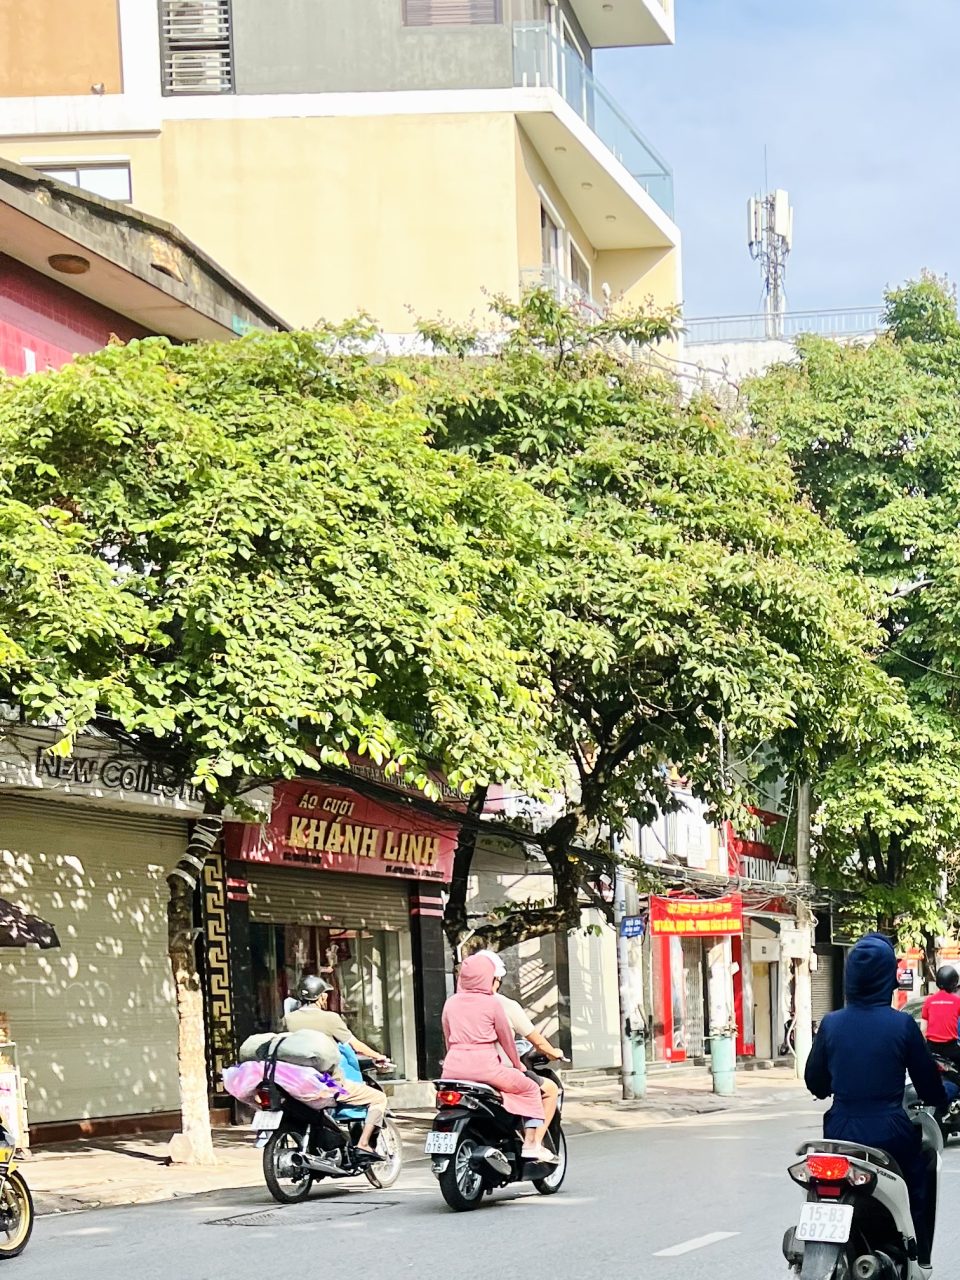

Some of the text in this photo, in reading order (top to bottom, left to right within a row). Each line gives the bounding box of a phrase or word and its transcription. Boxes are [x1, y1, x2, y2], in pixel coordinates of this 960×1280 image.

[288, 815, 440, 866] KHÁNH LINH
[799, 1222, 847, 1240] 687.23
